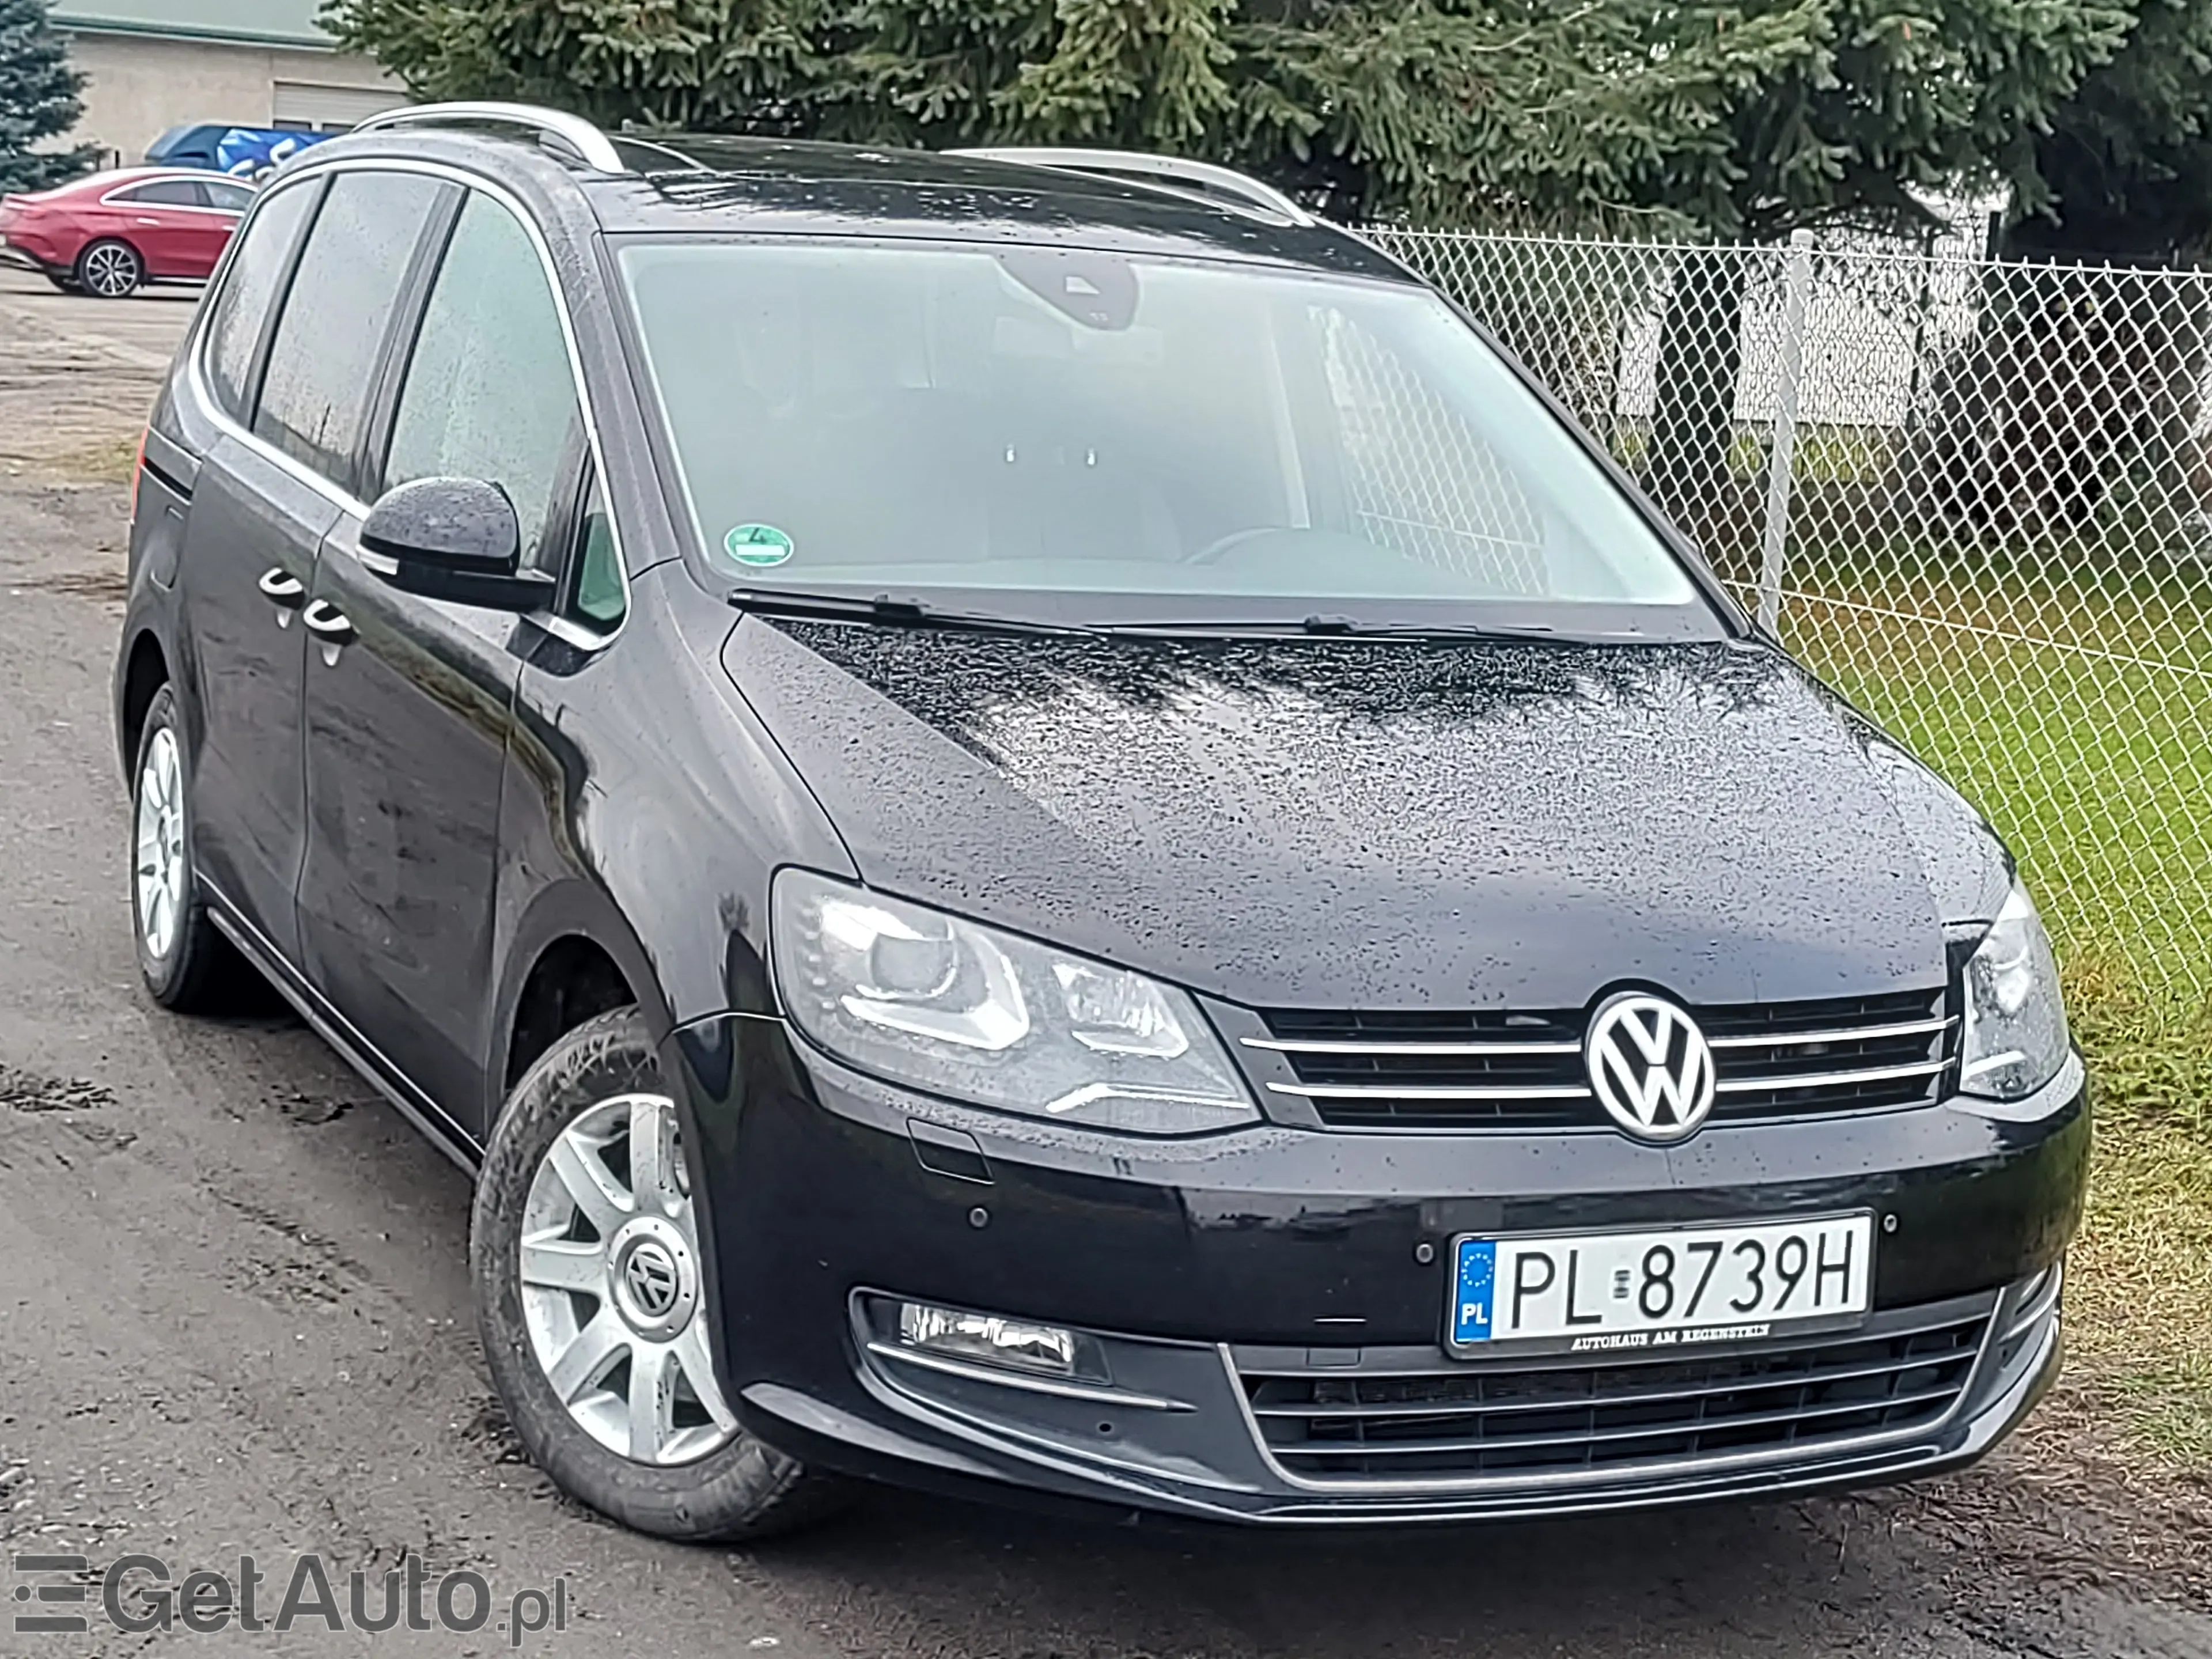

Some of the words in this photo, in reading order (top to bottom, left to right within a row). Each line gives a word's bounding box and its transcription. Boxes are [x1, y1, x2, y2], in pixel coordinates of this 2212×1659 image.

[748, 527, 767, 544] 4
[1588, 995, 1715, 1135] VW
[1511, 1249, 1603, 1330] PL
[1638, 1229, 1854, 1320] 8739H
[1461, 1302, 1488, 1325] PL
[1570, 1332, 1649, 1351] AUTOHAUS
[1652, 1330, 1678, 1345] AM
